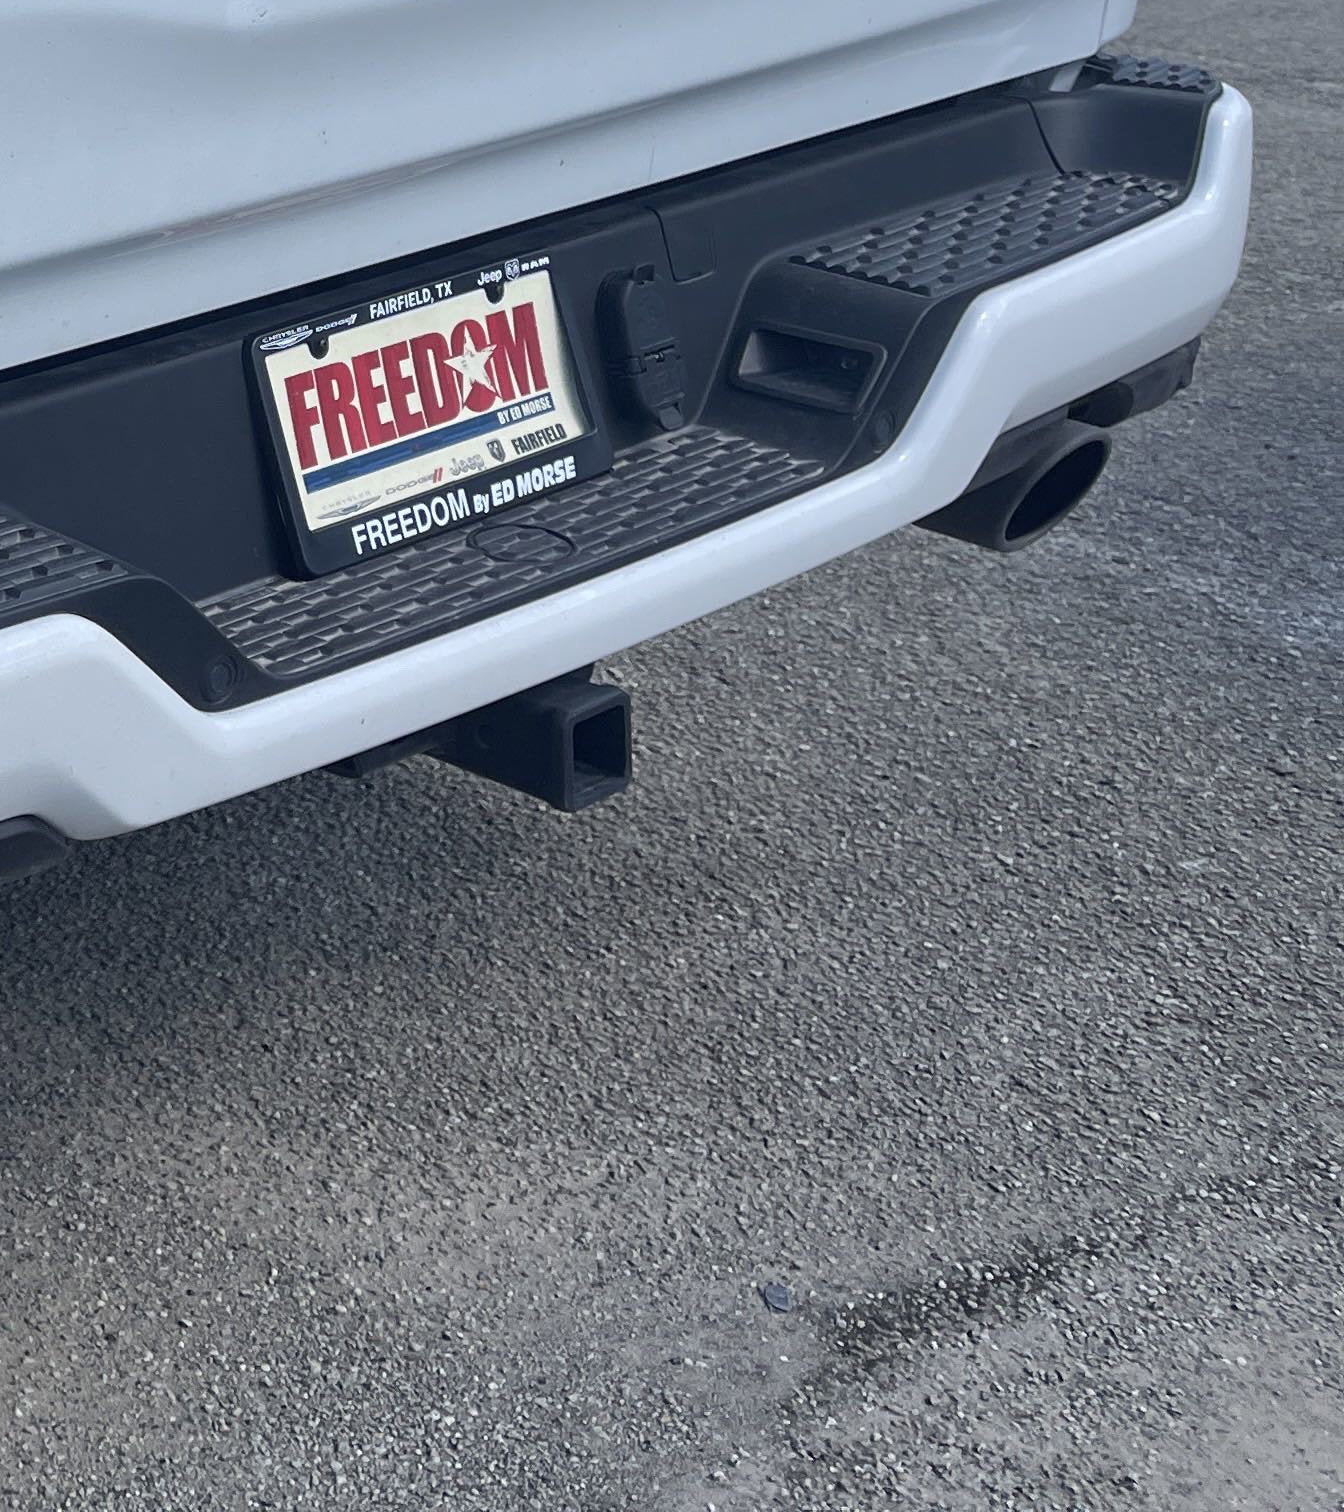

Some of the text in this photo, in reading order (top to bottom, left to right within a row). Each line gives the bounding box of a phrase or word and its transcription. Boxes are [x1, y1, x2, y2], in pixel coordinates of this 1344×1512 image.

[262, 256, 550, 343] CHRYSLER DODGE FAIRFIELD, TX Jeep RAM
[284, 302, 549, 470] FREEDOM
[497, 395, 552, 425] BY ED MORSE
[449, 453, 485, 477] Jeep
[511, 423, 568, 455] FAIRFIELD
[351, 455, 577, 555] FREEDOM By ED MORSE
